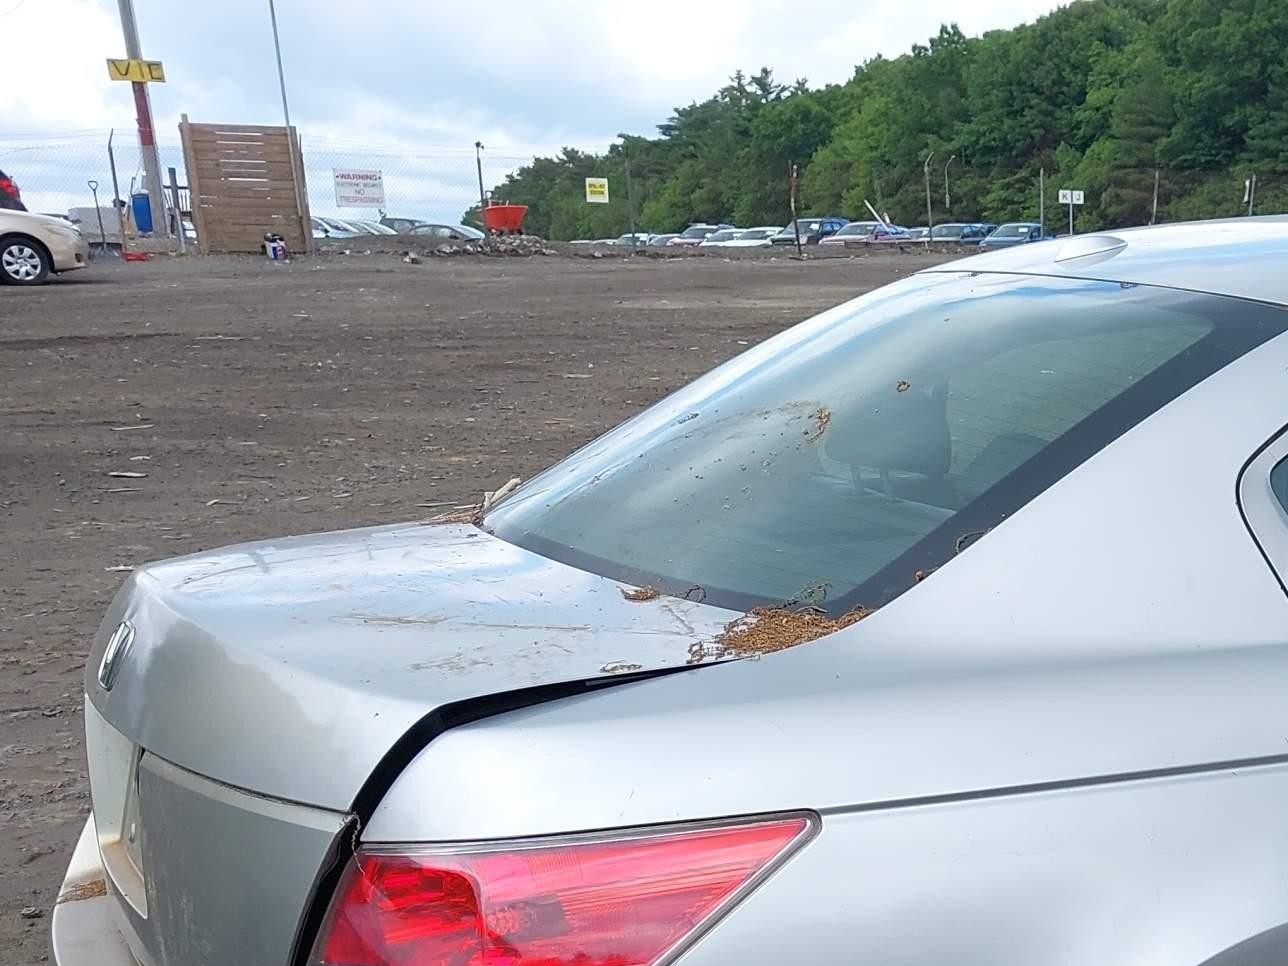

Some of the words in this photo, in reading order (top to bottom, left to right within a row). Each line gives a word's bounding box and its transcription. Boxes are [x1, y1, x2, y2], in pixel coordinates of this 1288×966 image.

[339, 173, 378, 181] WARNING
[339, 196, 383, 204] TRESPASSING
[1062, 192, 1069, 201] K
